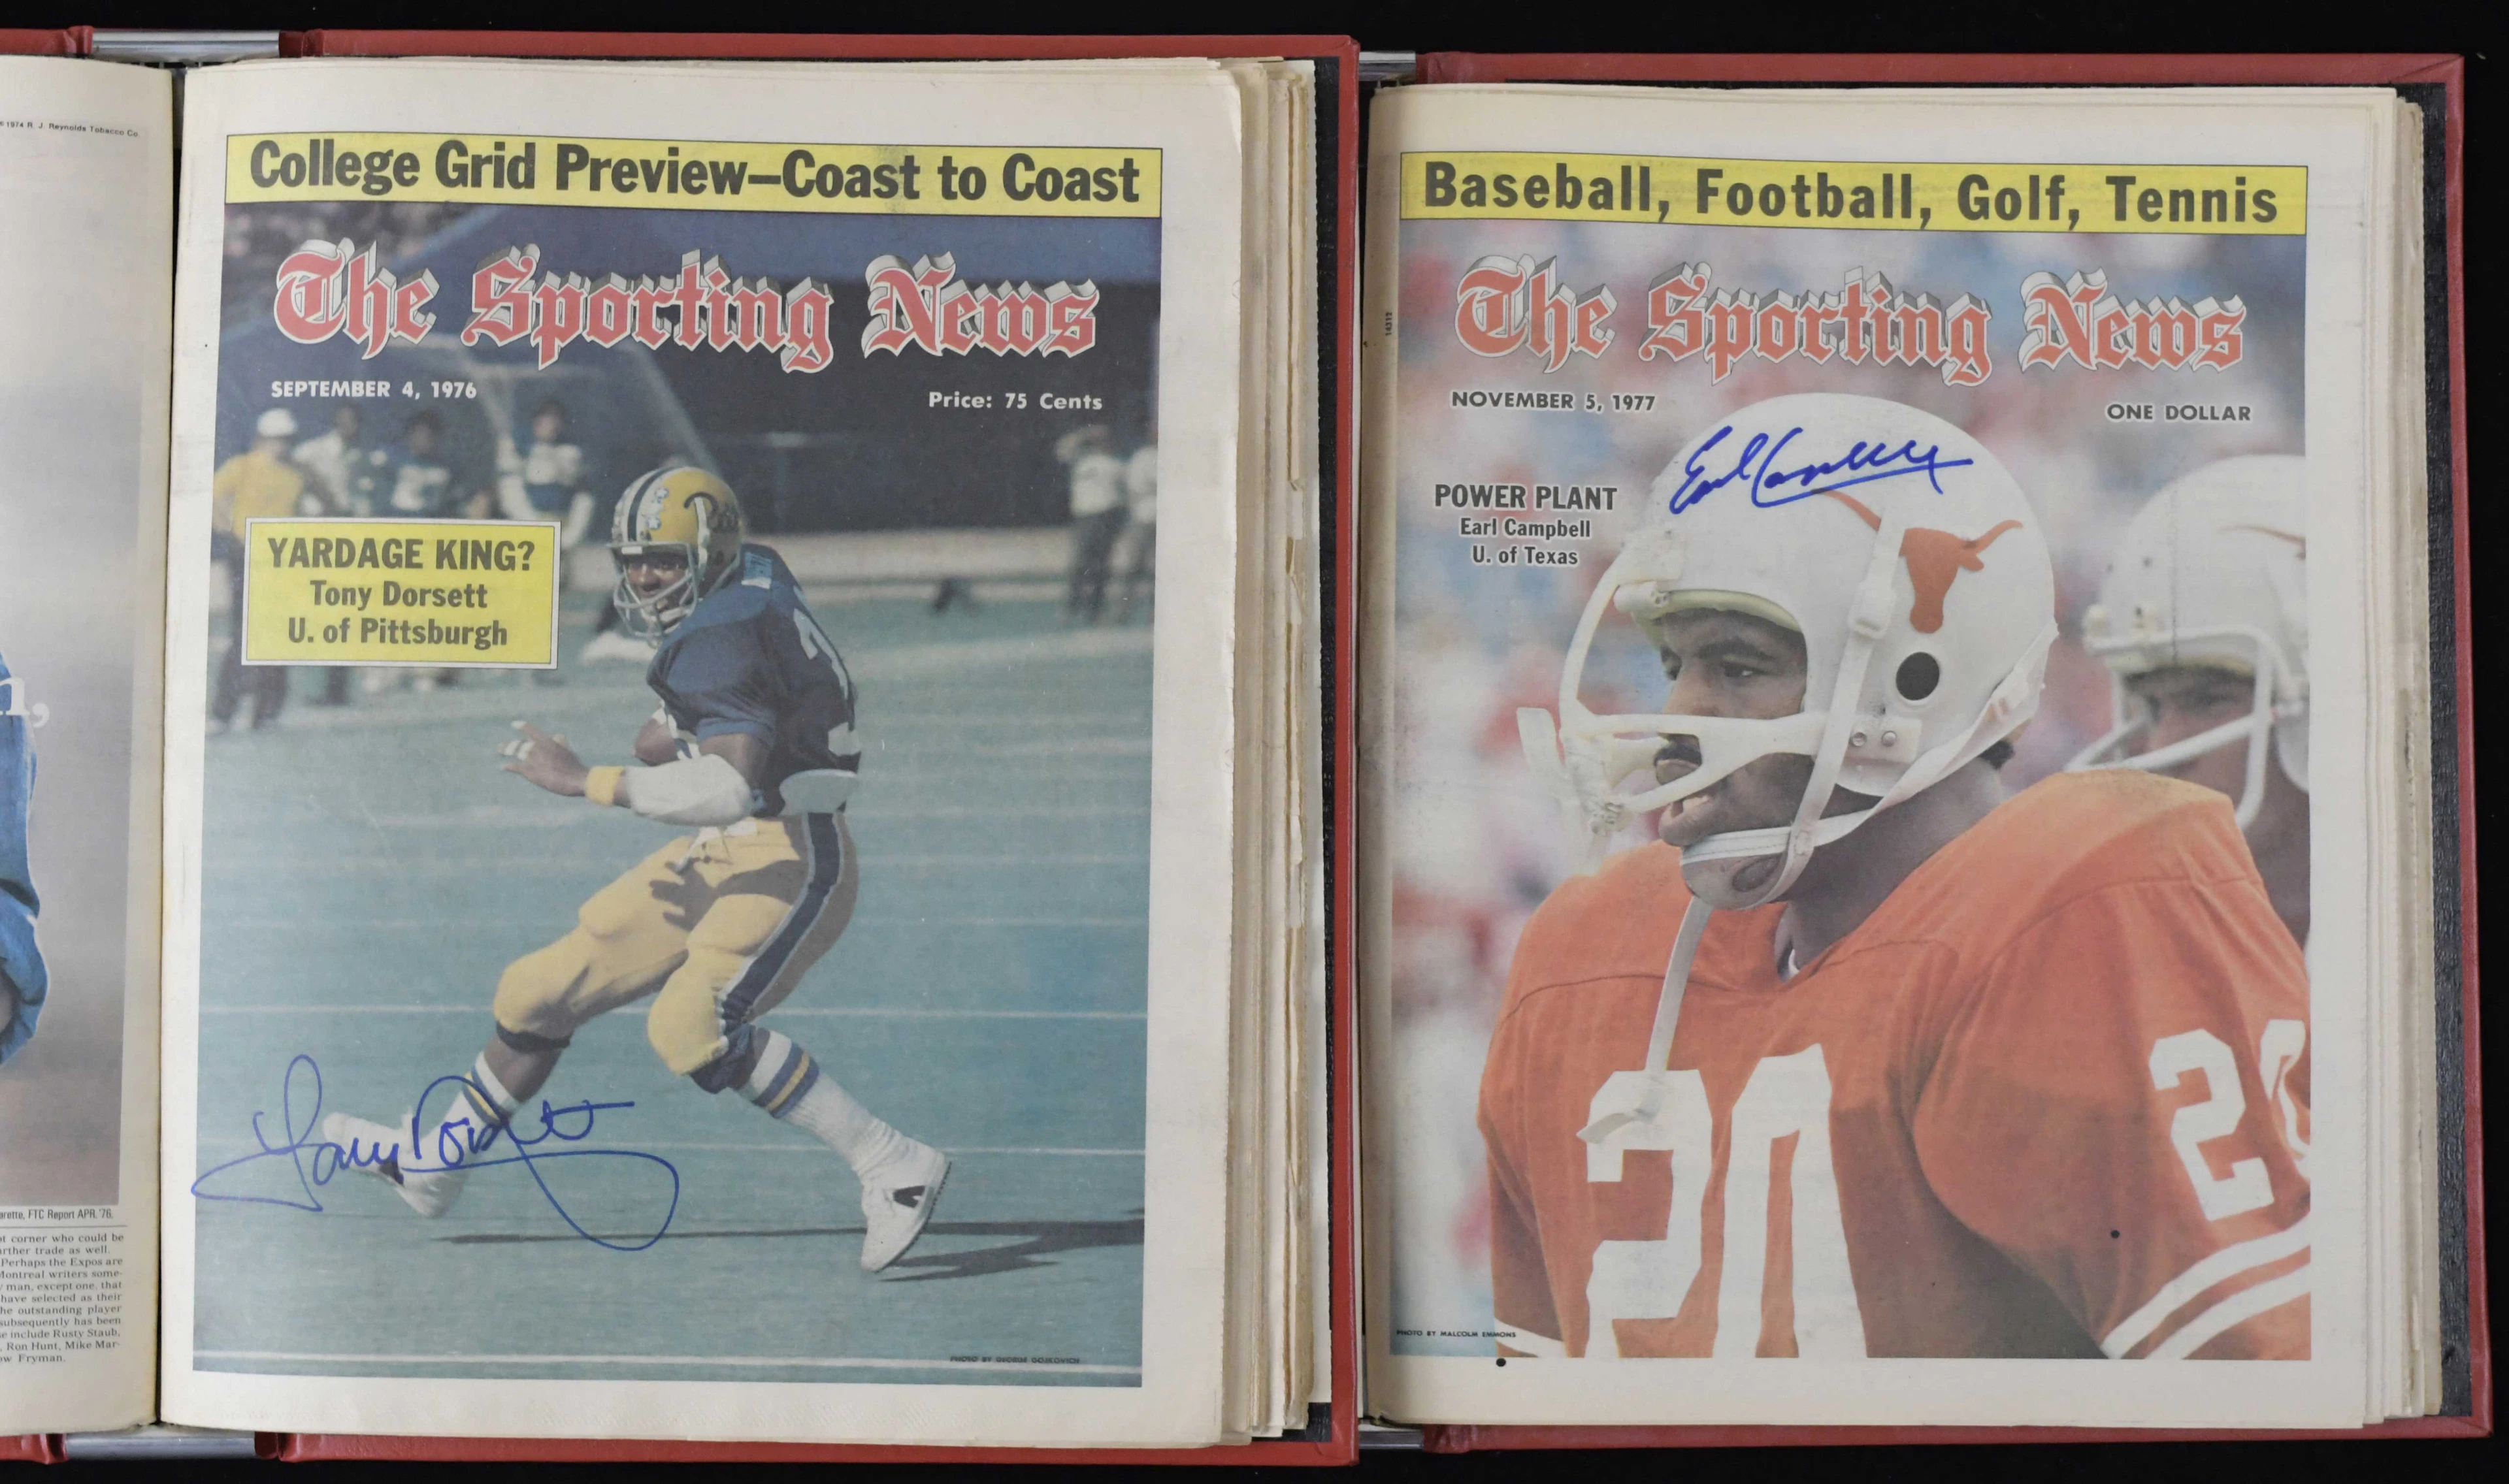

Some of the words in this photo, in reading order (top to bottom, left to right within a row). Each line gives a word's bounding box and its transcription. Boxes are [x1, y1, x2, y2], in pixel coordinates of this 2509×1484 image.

[48, 123, 87, 132] Reynolds
[90, 125, 125, 135] Tobacco
[250, 139, 421, 196] College
[435, 140, 536, 190] Grid
[938, 155, 987, 201] to
[1002, 153, 1140, 202] Coast
[1425, 161, 1670, 223] Baseball,
[1696, 169, 1931, 231] Football,
[1958, 174, 2080, 231] Golf,
[2105, 176, 2278, 223] Tennis
[273, 237, 440, 360] The
[460, 242, 834, 373] Sporting
[862, 251, 1100, 359] News
[1454, 253, 1618, 374] The
[1638, 262, 1992, 386] Sporting
[2018, 266, 2246, 372] News
[271, 381, 391, 398] SEPTEMBER
[402, 381, 420, 400] 4,
[431, 381, 477, 399] 1976
[929, 391, 992, 409] Price:
[1005, 392, 1028, 409] 75
[1040, 392, 1103, 410] Cents
[1451, 391, 1574, 409] NOVEMBER
[1586, 393, 1603, 411] 5,
[1612, 394, 1656, 411] 1977
[2107, 404, 2154, 420] ONE
[2166, 404, 2252, 421] DOLLAR
[1435, 484, 1527, 509] POWER
[1535, 486, 1618, 511] PLANT
[1460, 518, 1498, 537] Earl
[1504, 519, 1591, 541] Campbell
[267, 537, 424, 569] YARDAGE
[435, 539, 536, 571] KING?
[1472, 546, 1492, 564] U.
[1498, 546, 1518, 564] of
[1524, 547, 1579, 566] Texas
[310, 580, 372, 611] Tony
[383, 581, 487, 609] Dorsett
[288, 617, 314, 643] U.
[323, 617, 350, 644] of
[360, 618, 508, 650] Pittsburgh
[28, 1209, 44, 1219] FTC
[47, 1209, 74, 1221] Report
[77, 1208, 97, 1219] APR.
[52, 1233, 74, 1242] who
[78, 1233, 107, 1242] could
[112, 1233, 124, 1242] be
[35, 1246, 64, 1255] trade
[86, 1245, 110, 1254] well.
[1, 1257, 46, 1268] Perhaps
[49, 1257, 66, 1266] the
[70, 1257, 103, 1268] Expos
[49, 1269, 88, 1279] writers
[37, 1283, 73, 1292] except
[101, 1281, 122, 1289] that
[1, 1293, 27, 1304] have
[31, 1293, 76, 1303] selected
[97, 1293, 122, 1302] their
[18, 1304, 82, 1315] outstanding
[88, 1304, 122, 1315] player
[74, 1316, 93, 1325] has
[96, 1315, 122, 1325] been
[10, 1329, 50, 1338] include
[53, 1329, 84, 1339] Rusty
[7, 1342, 28, 1351] Ron
[31, 1341, 61, 1351] Hunt,
[65, 1340, 92, 1349] Mike
[18, 1353, 66, 1364] Fryman.
